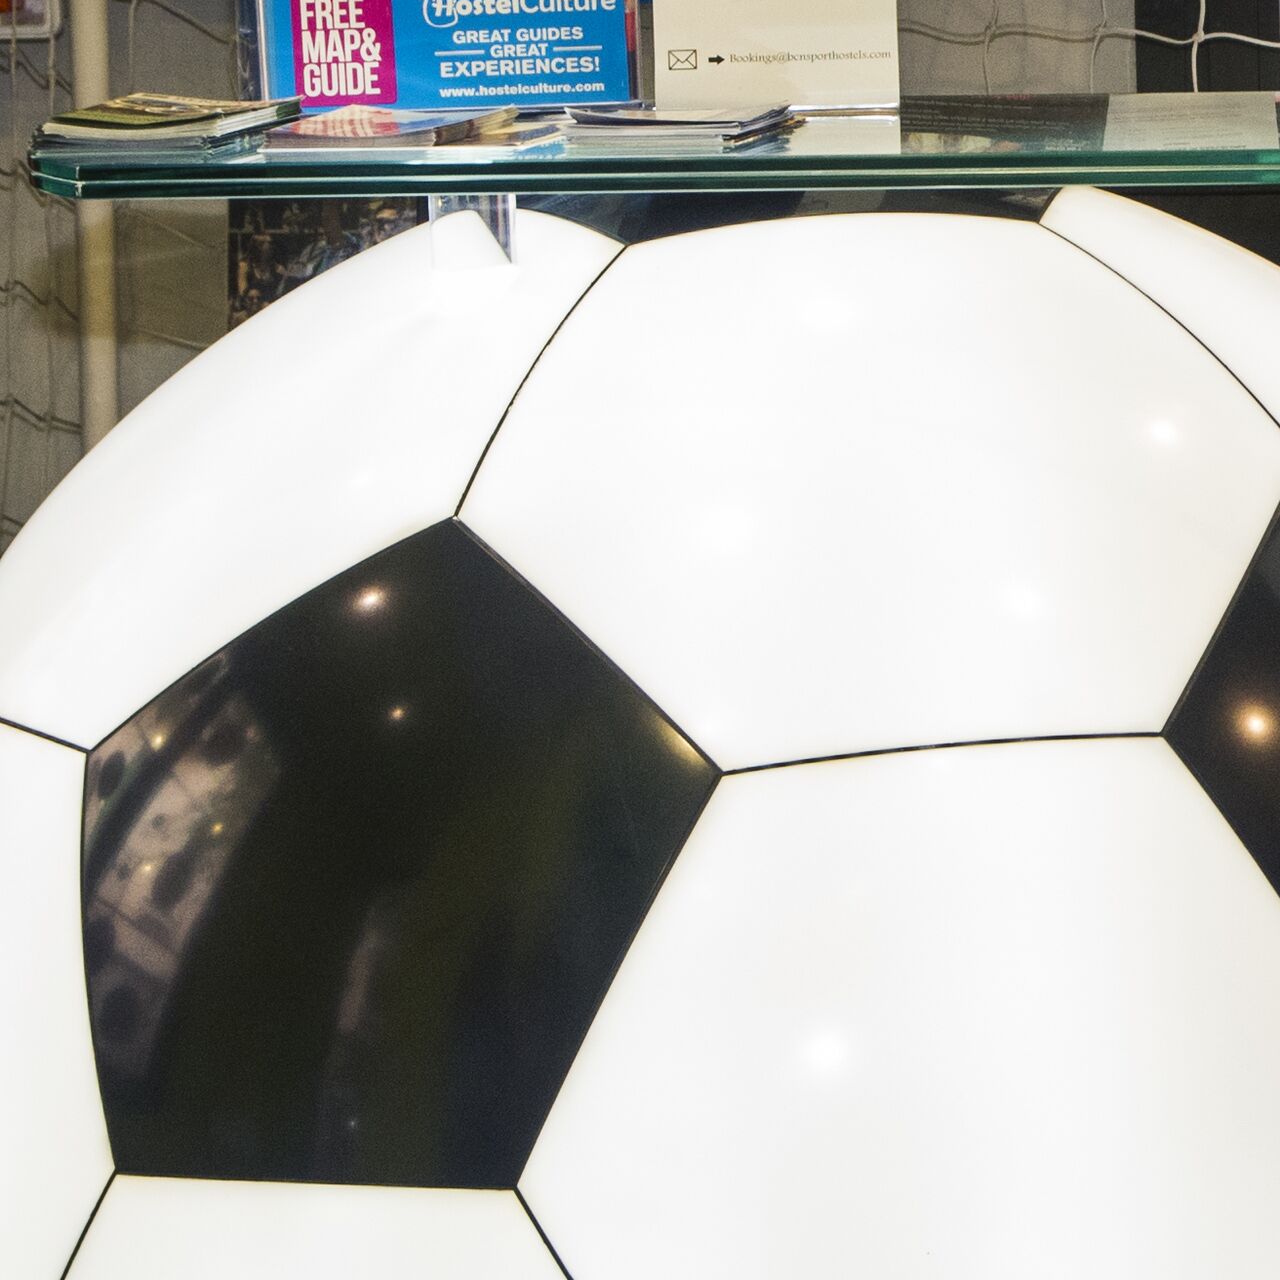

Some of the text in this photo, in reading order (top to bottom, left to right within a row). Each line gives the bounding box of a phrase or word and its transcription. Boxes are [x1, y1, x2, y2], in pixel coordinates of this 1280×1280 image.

[453, 27, 583, 45] GREAT GUIDES
[302, 28, 382, 64] MAP&
[490, 43, 548, 58] GREAT
[440, 57, 600, 78] EXPERIENCES!
[303, 61, 381, 98] GUIDE
[440, 81, 605, 98] www.hostelculture.com
